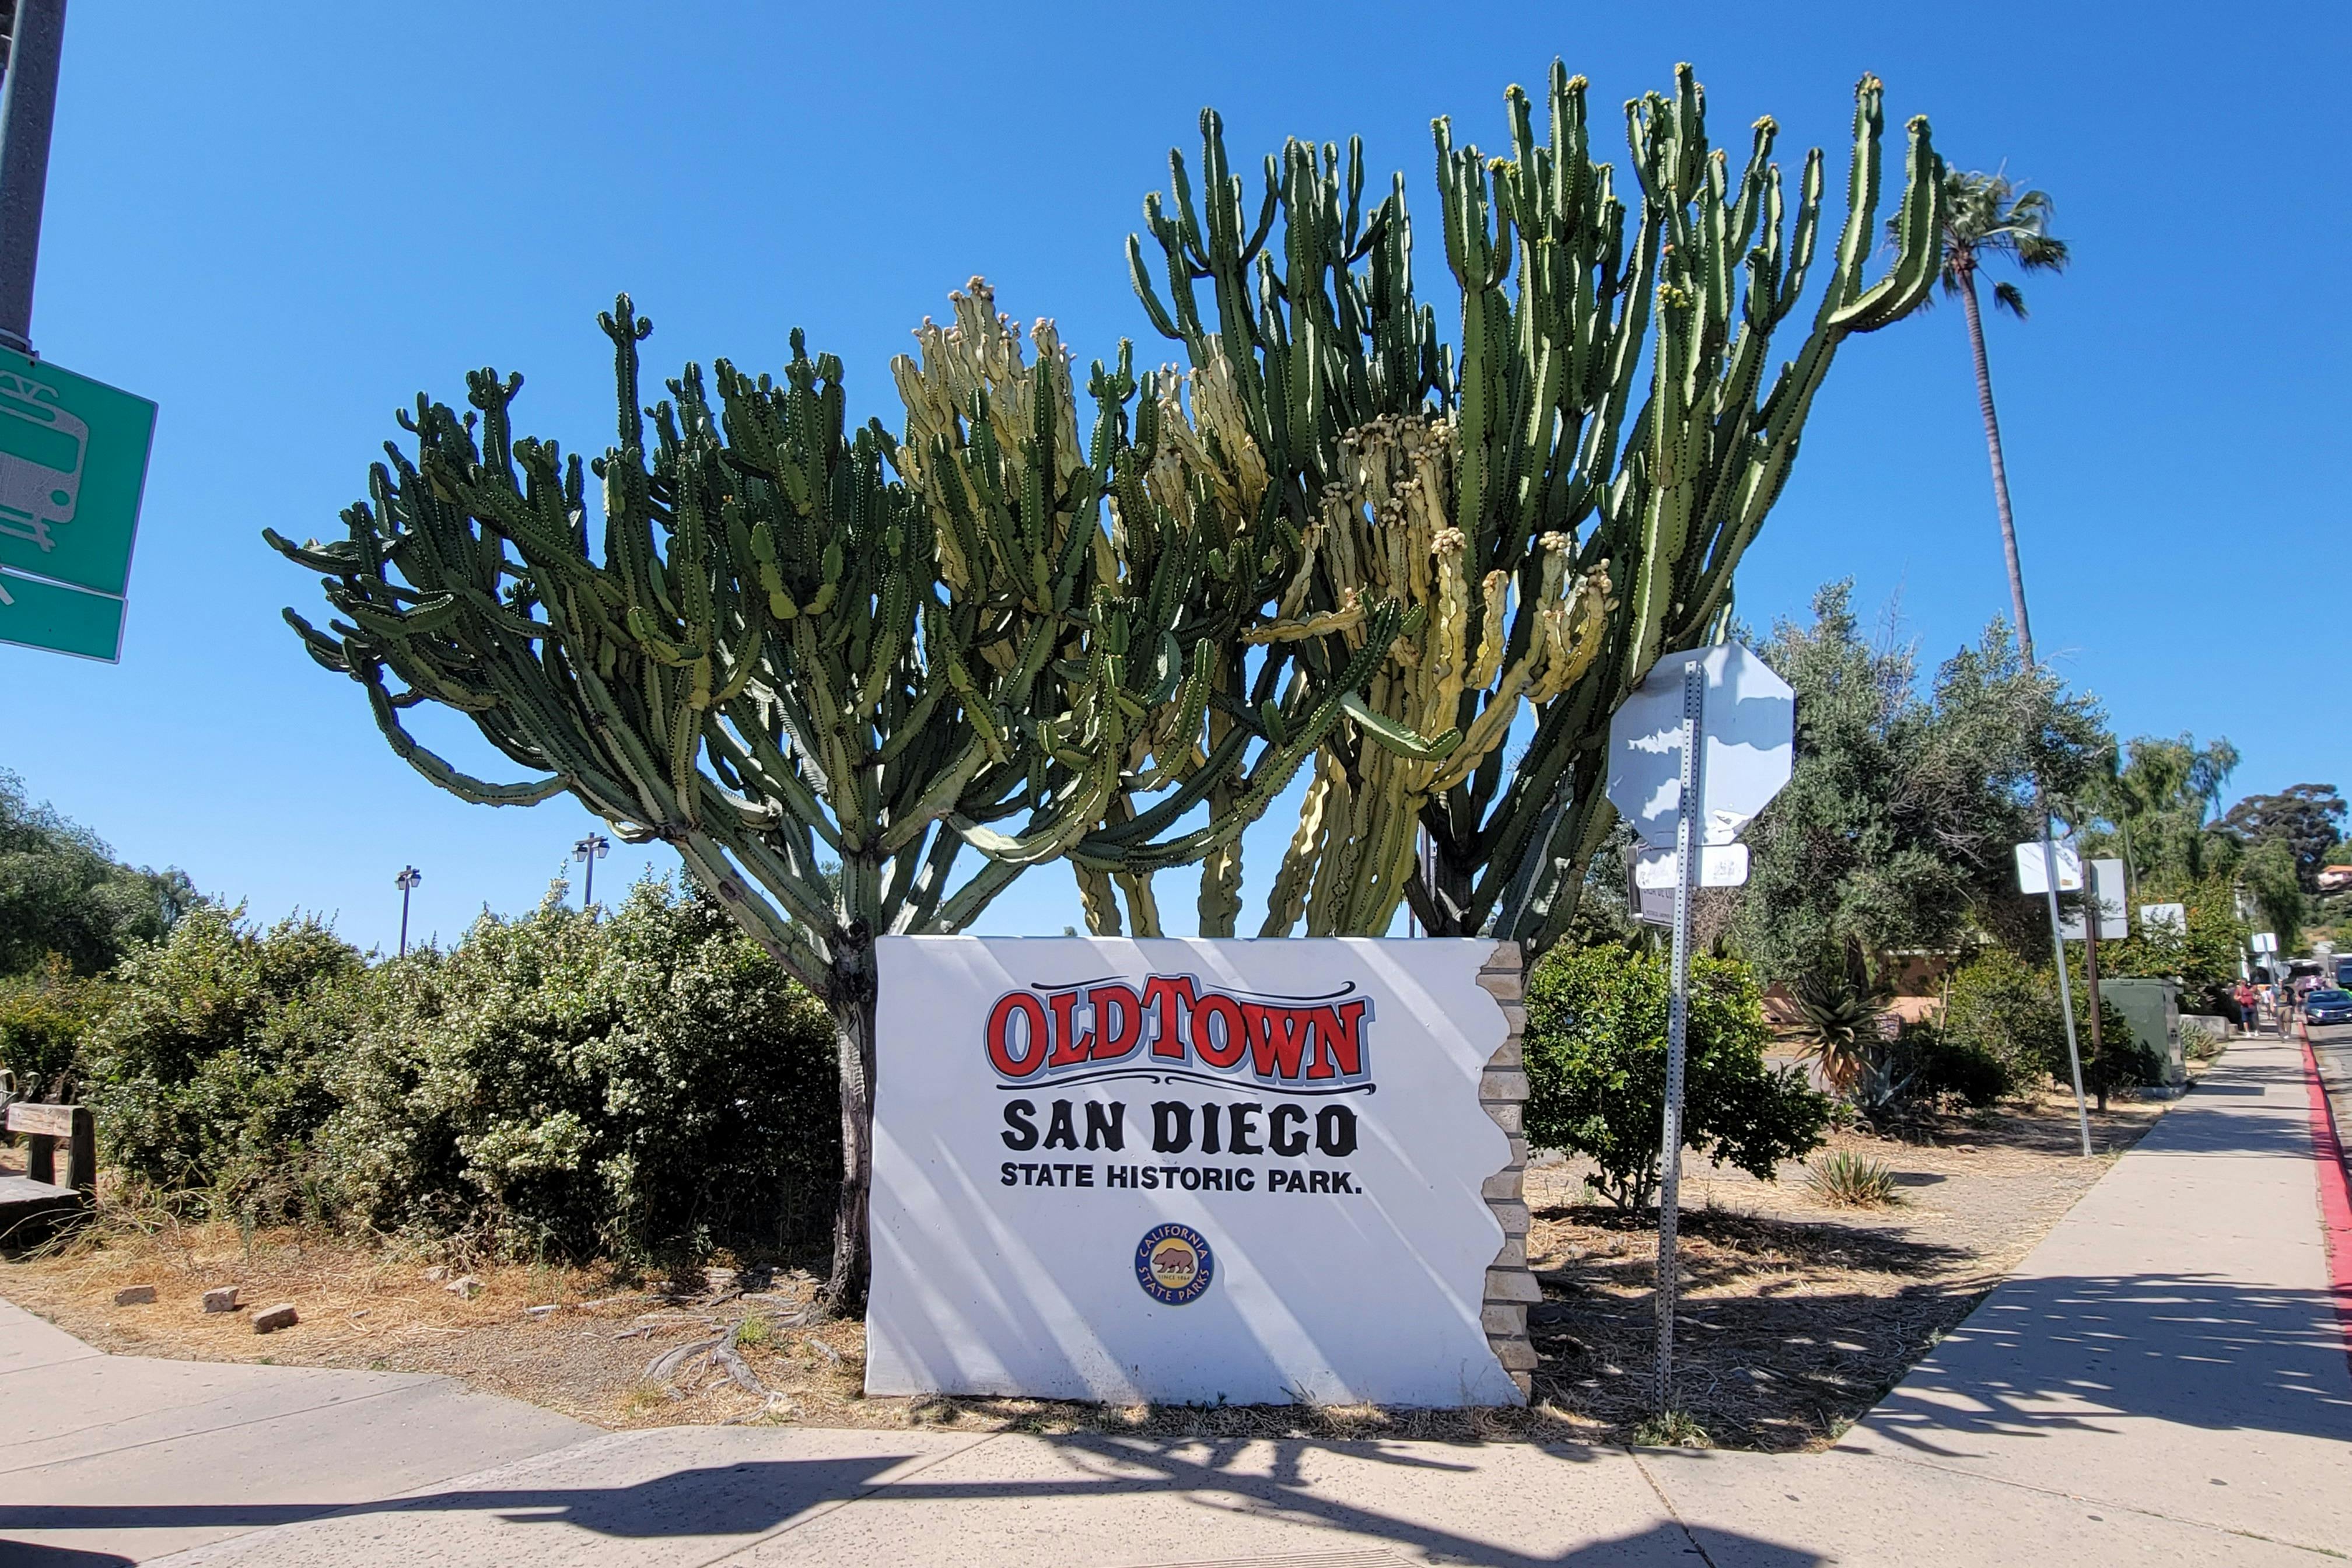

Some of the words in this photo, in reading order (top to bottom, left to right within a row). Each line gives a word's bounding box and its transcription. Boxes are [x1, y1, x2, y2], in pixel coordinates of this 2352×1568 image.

[1000, 1099, 1126, 1152] SAN
[1151, 1101, 1358, 1157] DIEGO
[1000, 1162, 1094, 1187] STATE
[1107, 1165, 1255, 1191] HISTORIC
[1268, 1170, 1362, 1194] PARK.
[1140, 1226, 1208, 1259] CALIFORNIA
[1139, 1266, 1172, 1301] STATE
[1178, 1269, 1209, 1301] PARKS
